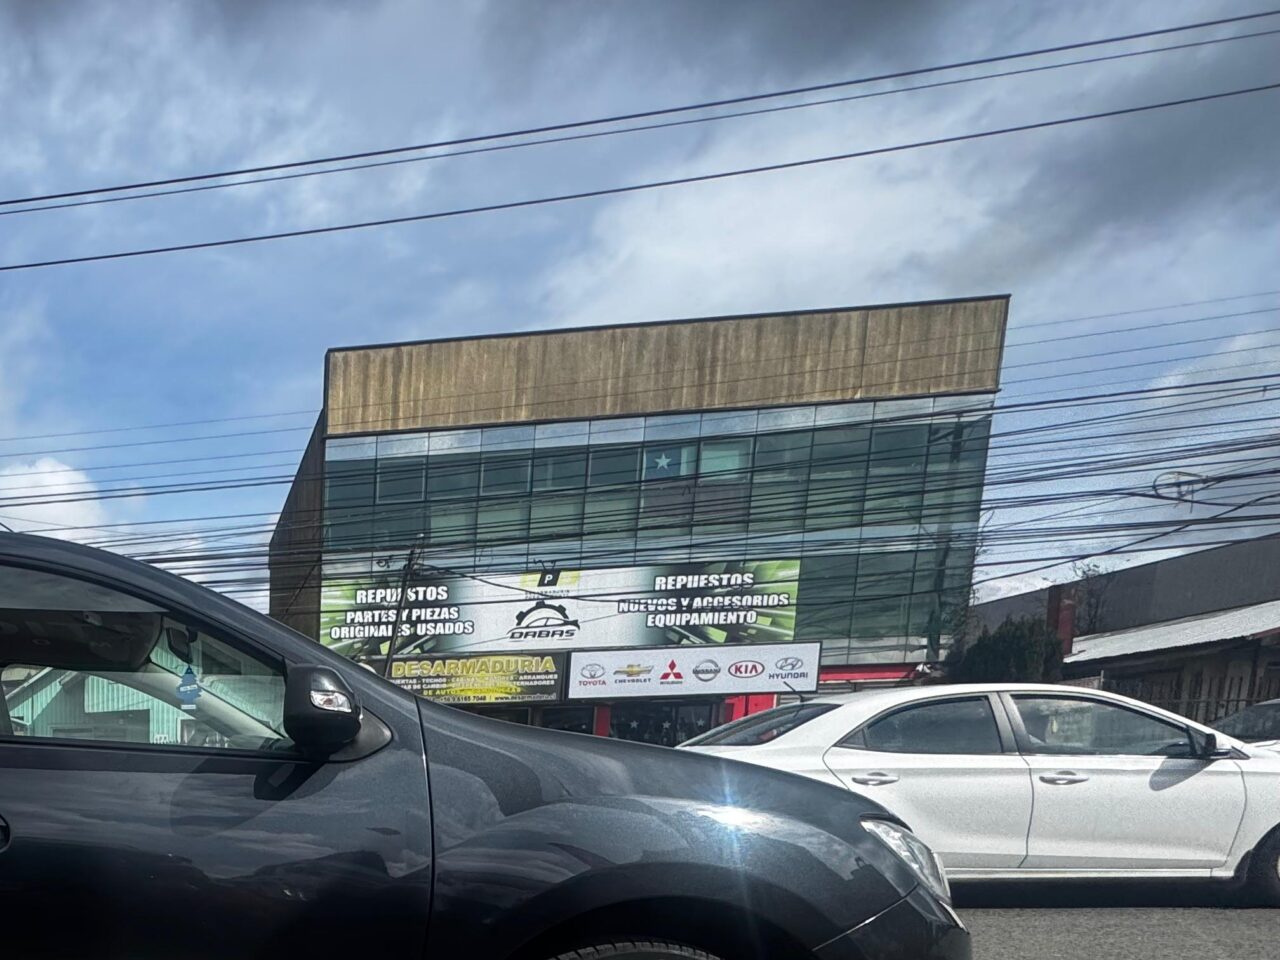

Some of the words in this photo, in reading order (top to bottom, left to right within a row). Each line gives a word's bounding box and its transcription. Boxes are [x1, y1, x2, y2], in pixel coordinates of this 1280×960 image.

[544, 574, 553, 584] P
[655, 573, 754, 590] REPUESTOS
[356, 586, 448, 604] REPUSTOS
[618, 598, 677, 612] NUEVOS
[681, 597, 689, 610] Y
[692, 594, 790, 610] ACCESORIOS
[346, 610, 397, 623] PARTES
[402, 609, 410, 621] Y
[412, 607, 458, 620] PIEZAS
[646, 611, 758, 627] EQUIPAMIENTO
[416, 622, 474, 636] USADOS
[510, 629, 576, 639] DABAS
[392, 656, 556, 678] DESARMADURIA
[734, 664, 759, 675] KIA
[769, 672, 809, 680] HYUNDAI
